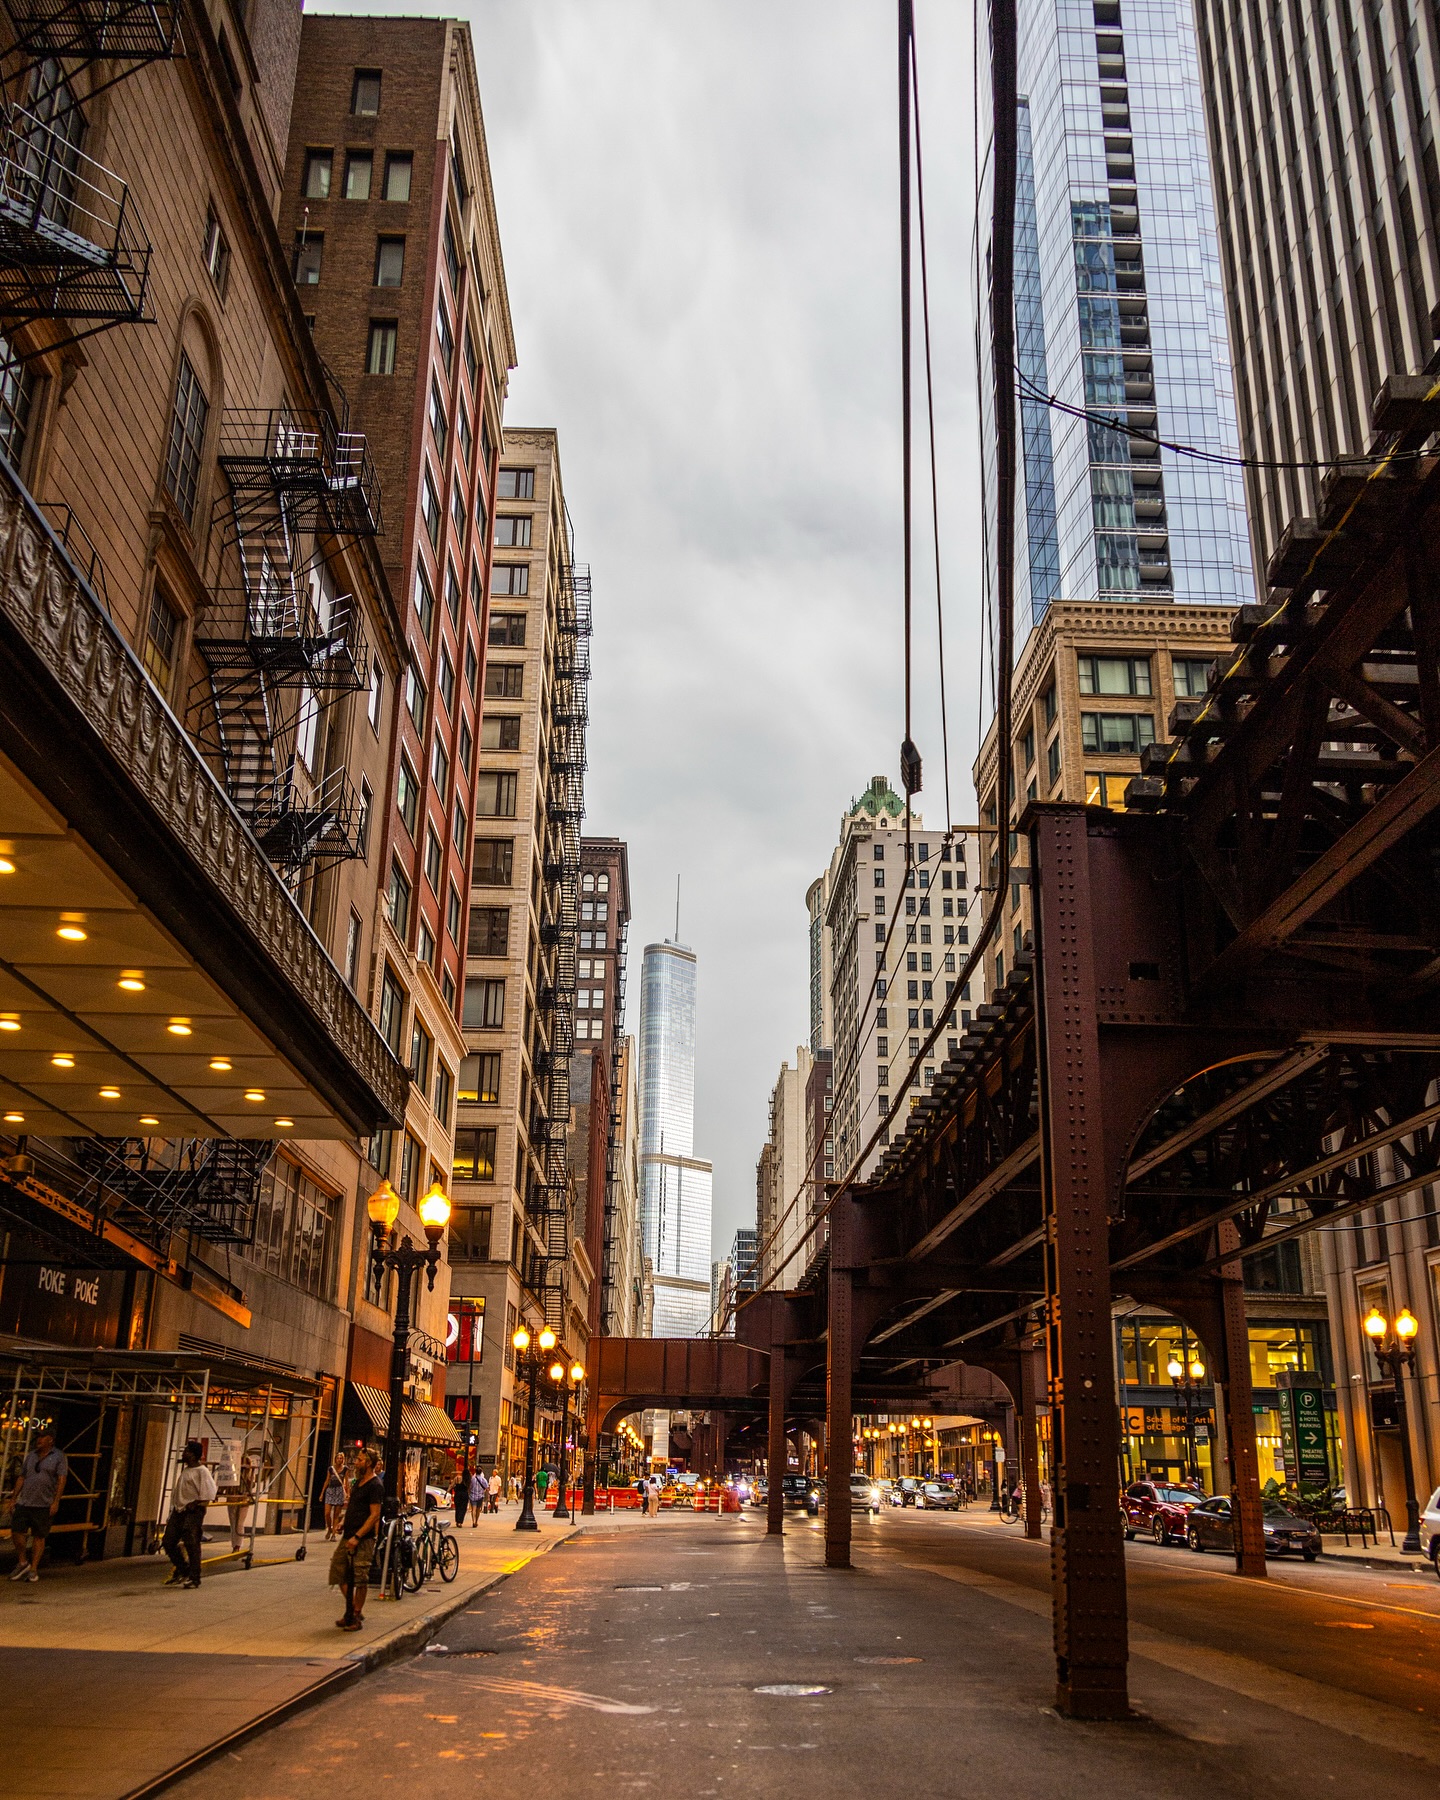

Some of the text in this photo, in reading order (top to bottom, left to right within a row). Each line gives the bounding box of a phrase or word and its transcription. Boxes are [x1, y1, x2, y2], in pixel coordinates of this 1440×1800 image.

[39, 1266, 99, 1306] POKE POKÉ
[1172, 1415, 1180, 1423] of
[1156, 1424, 1186, 1432] Chicago
